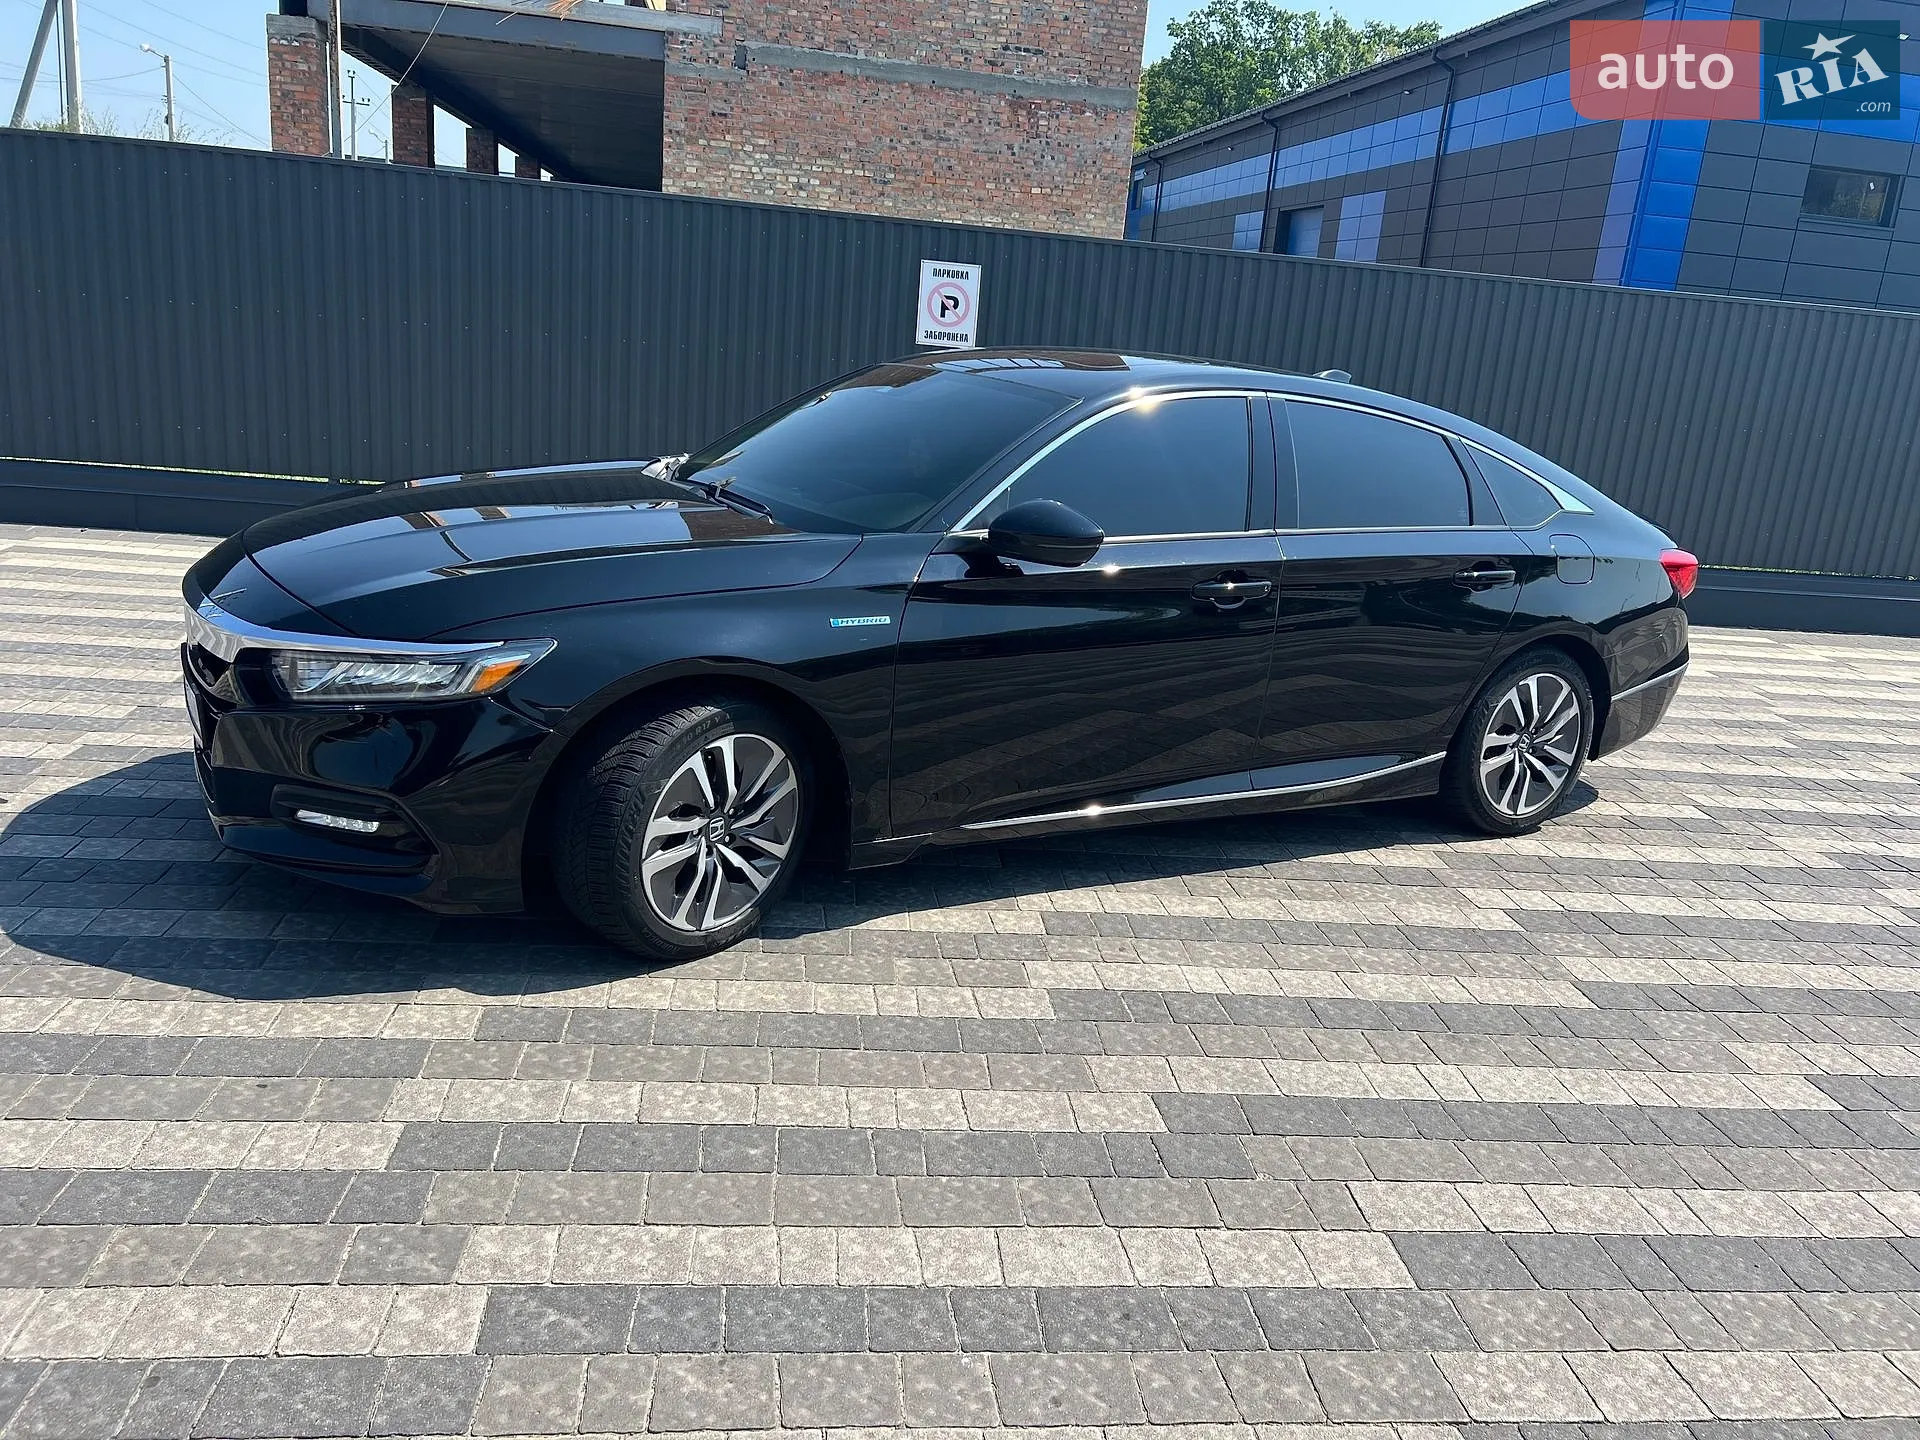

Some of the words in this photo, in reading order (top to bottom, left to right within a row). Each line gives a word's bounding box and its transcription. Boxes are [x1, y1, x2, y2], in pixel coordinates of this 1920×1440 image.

[932, 268, 969, 280] ПАРКОВКА
[924, 330, 969, 343] ЗАБОРОНЕНА
[840, 617, 887, 625] HYBRID
